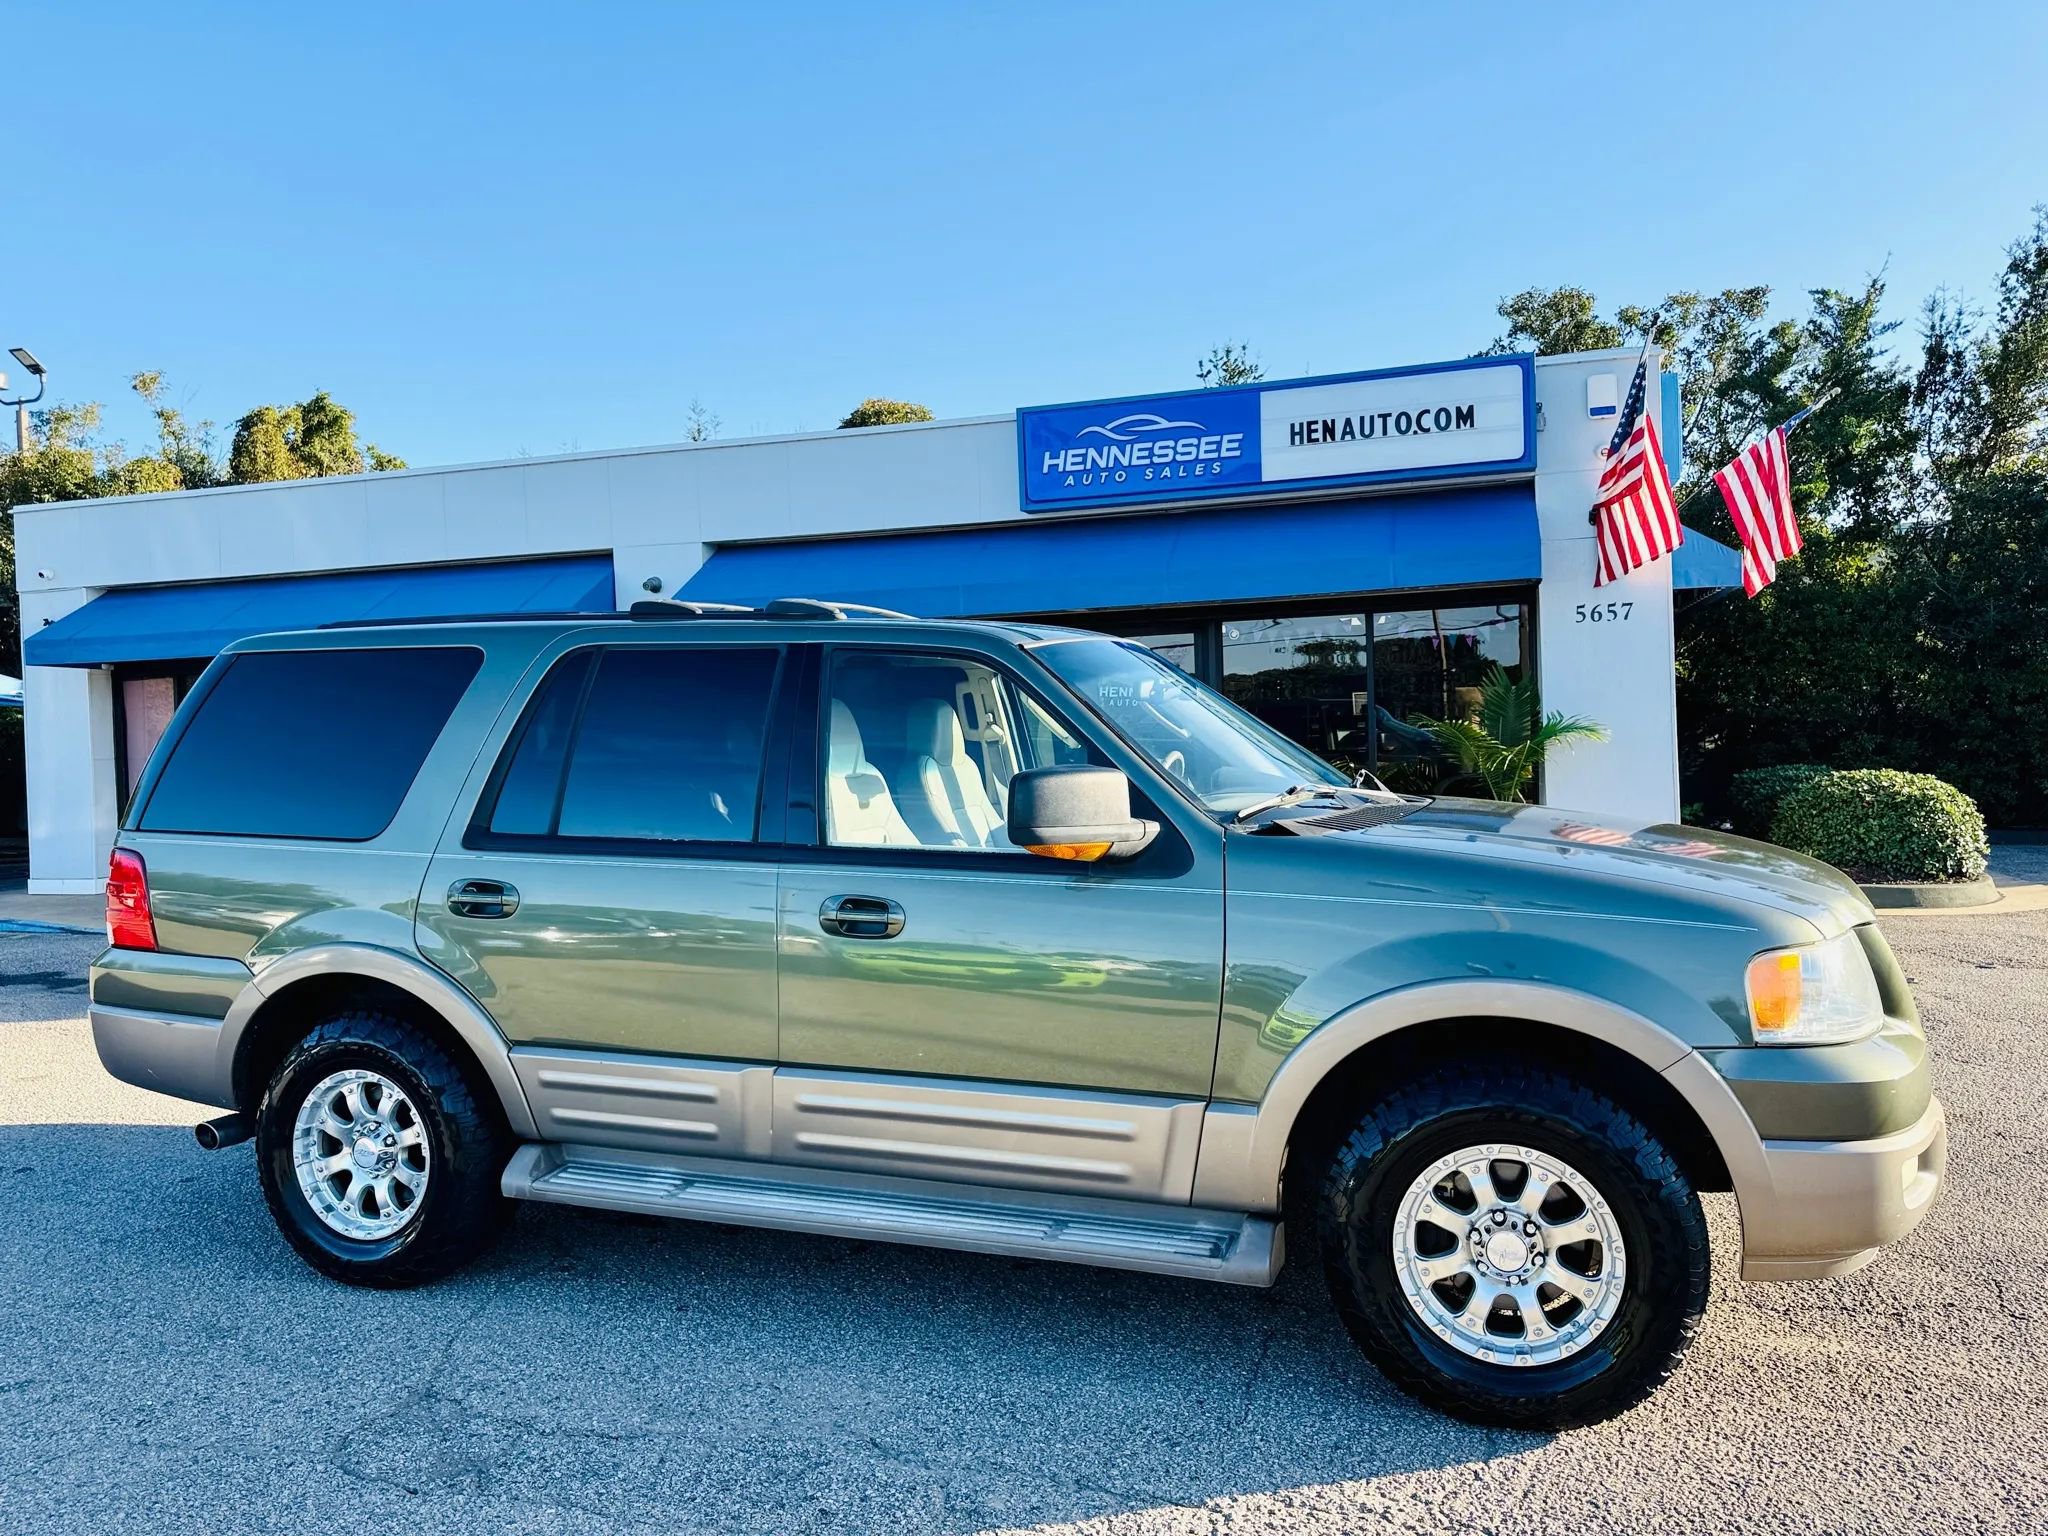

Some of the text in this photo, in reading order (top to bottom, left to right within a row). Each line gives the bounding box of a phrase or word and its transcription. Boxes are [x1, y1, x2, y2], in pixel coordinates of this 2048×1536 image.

[1290, 405, 1475, 446] HENAUTO.COM
[1042, 433, 1243, 473] HENNESSEE
[1064, 462, 1222, 487] AUTO SALES
[1575, 601, 1634, 623] 5657
[1109, 699, 1138, 707] AUTO
